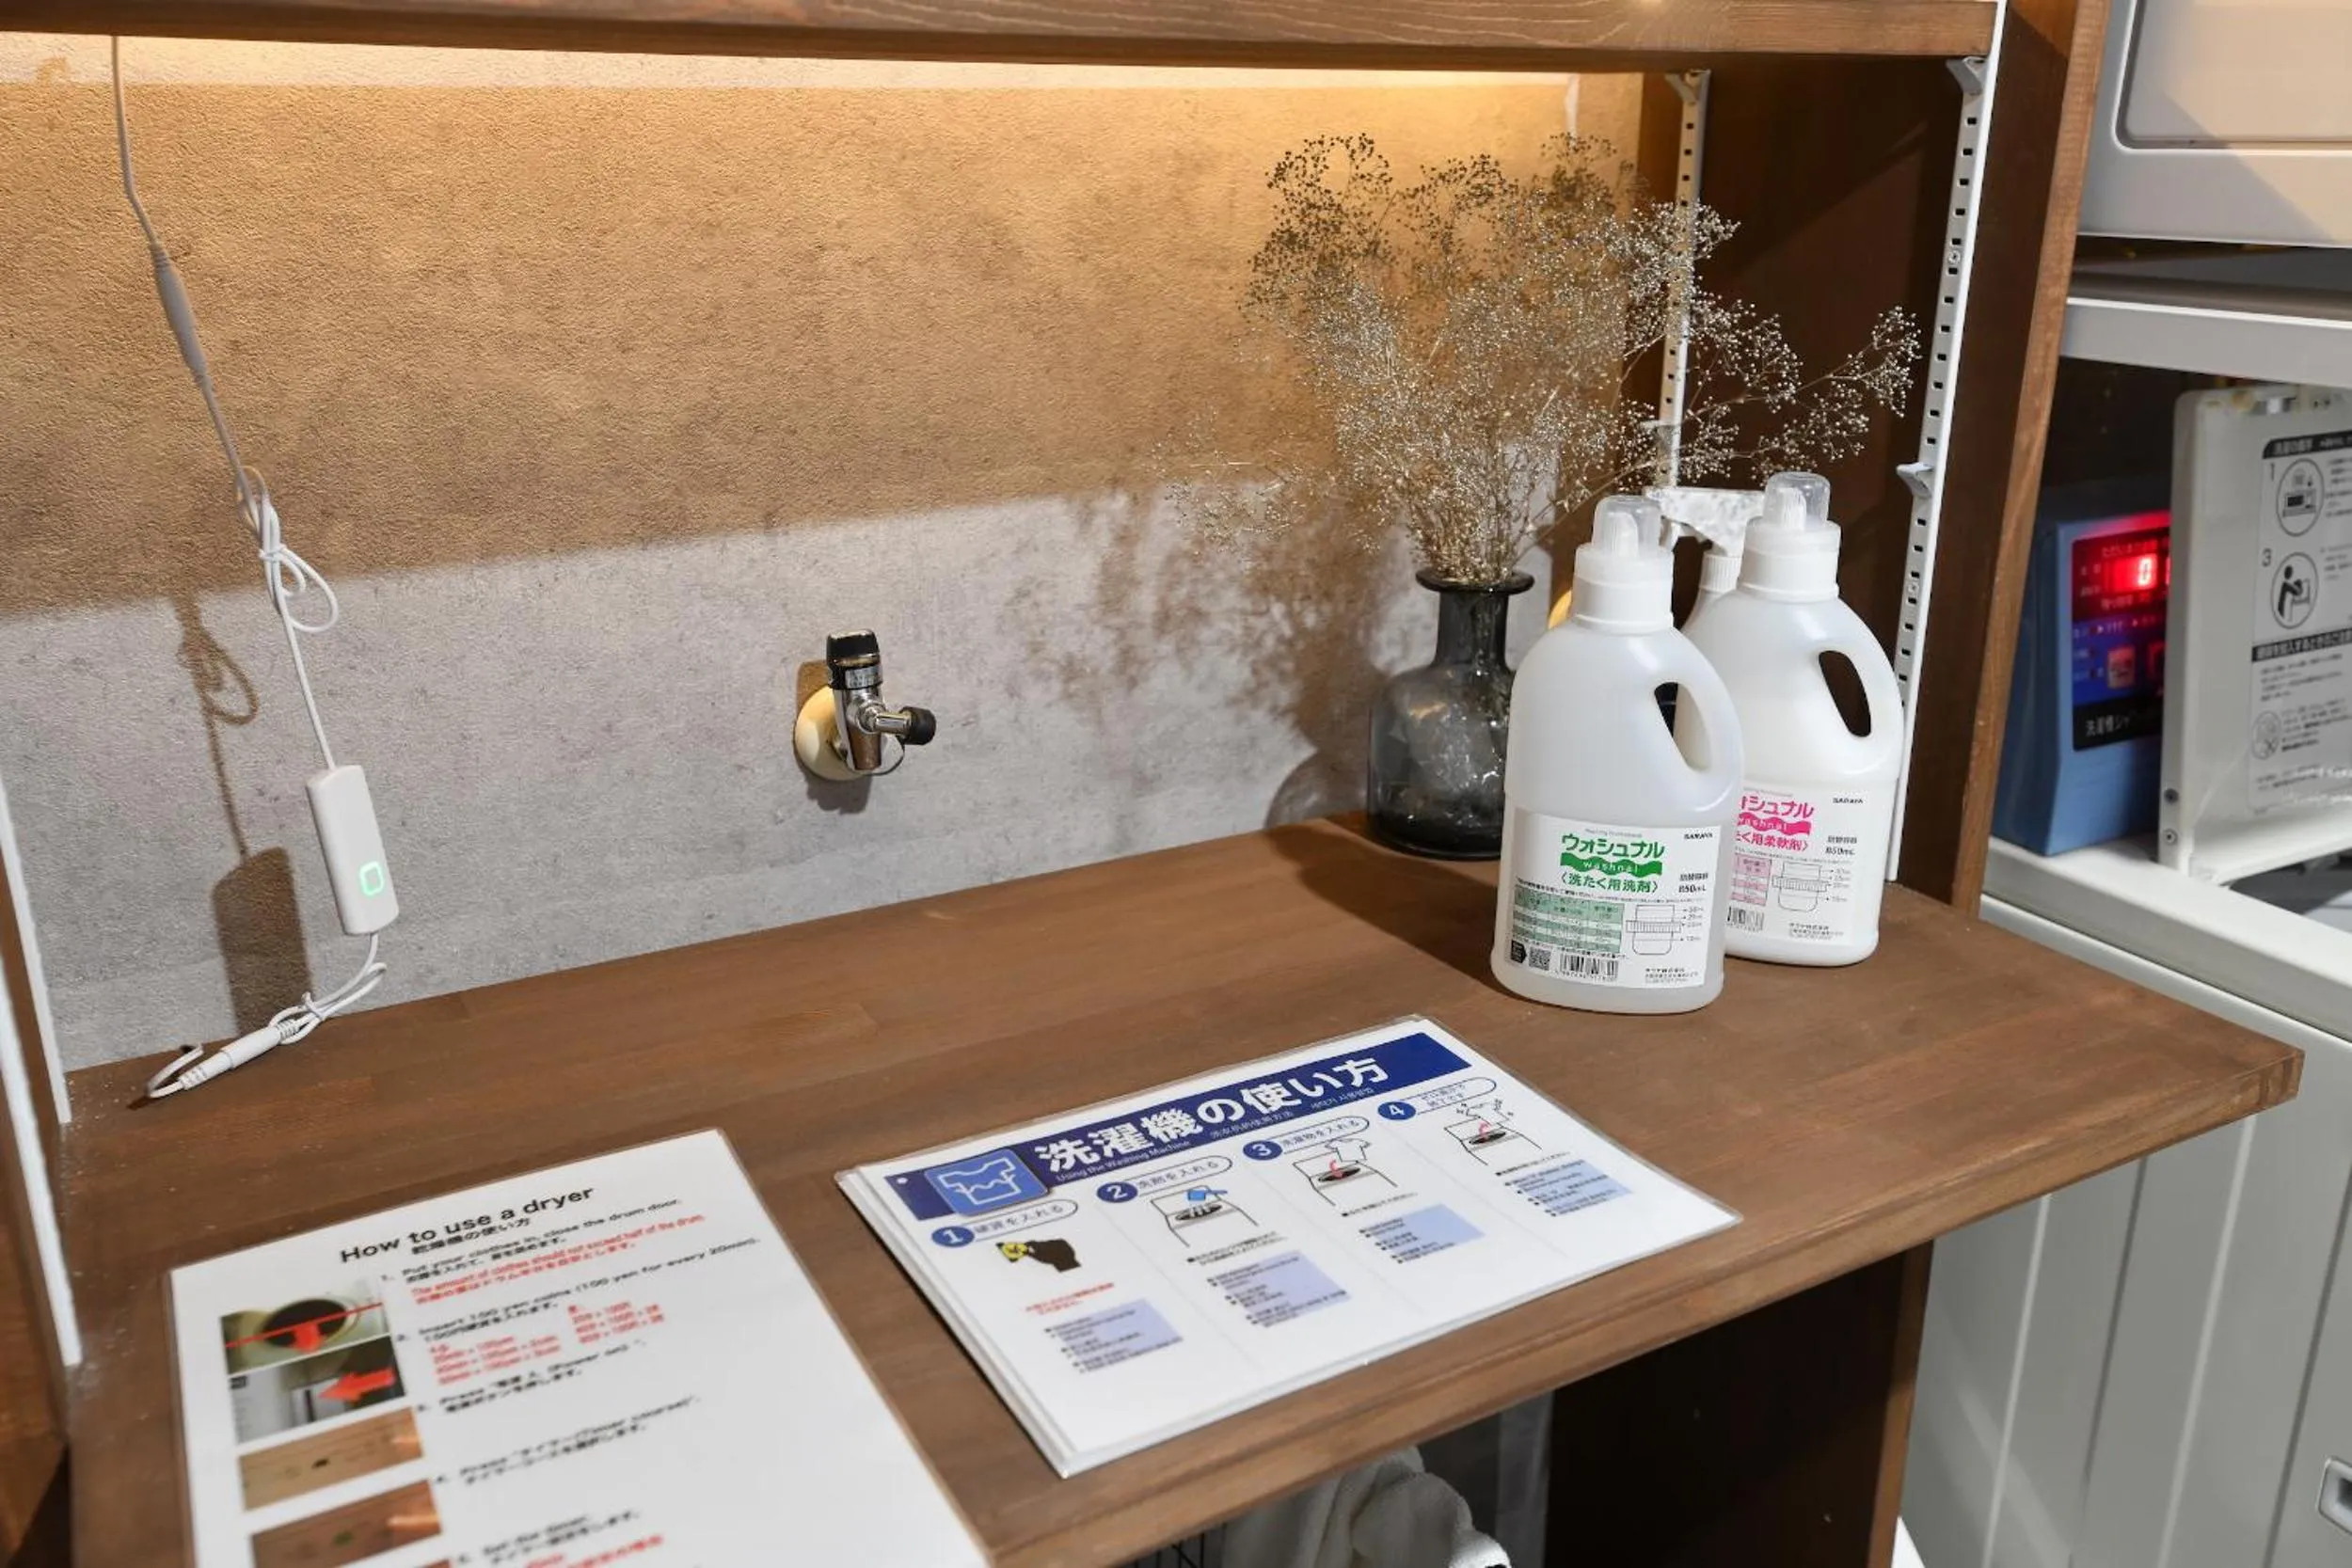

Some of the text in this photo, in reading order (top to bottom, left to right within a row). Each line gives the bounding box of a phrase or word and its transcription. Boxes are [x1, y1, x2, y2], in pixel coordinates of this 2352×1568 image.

[1562, 832, 1665, 859] ウォシュナル
[1035, 1056, 1389, 1173] 洗濯機の使い方
[1388, 1104, 1406, 1117] 4
[1055, 1139, 1193, 1182] Using the Washing Machine
[1252, 1143, 1272, 1157] 3
[1105, 1183, 1128, 1200] 2
[340, 1187, 595, 1262] How to use a dryer
[945, 1228, 963, 1244] 1
[402, 1265, 428, 1275] Put
[432, 1256, 464, 1271] your
[469, 1241, 520, 1258] clothes
[544, 1225, 580, 1238] close
[583, 1219, 605, 1227] the
[610, 1209, 645, 1221] drum
